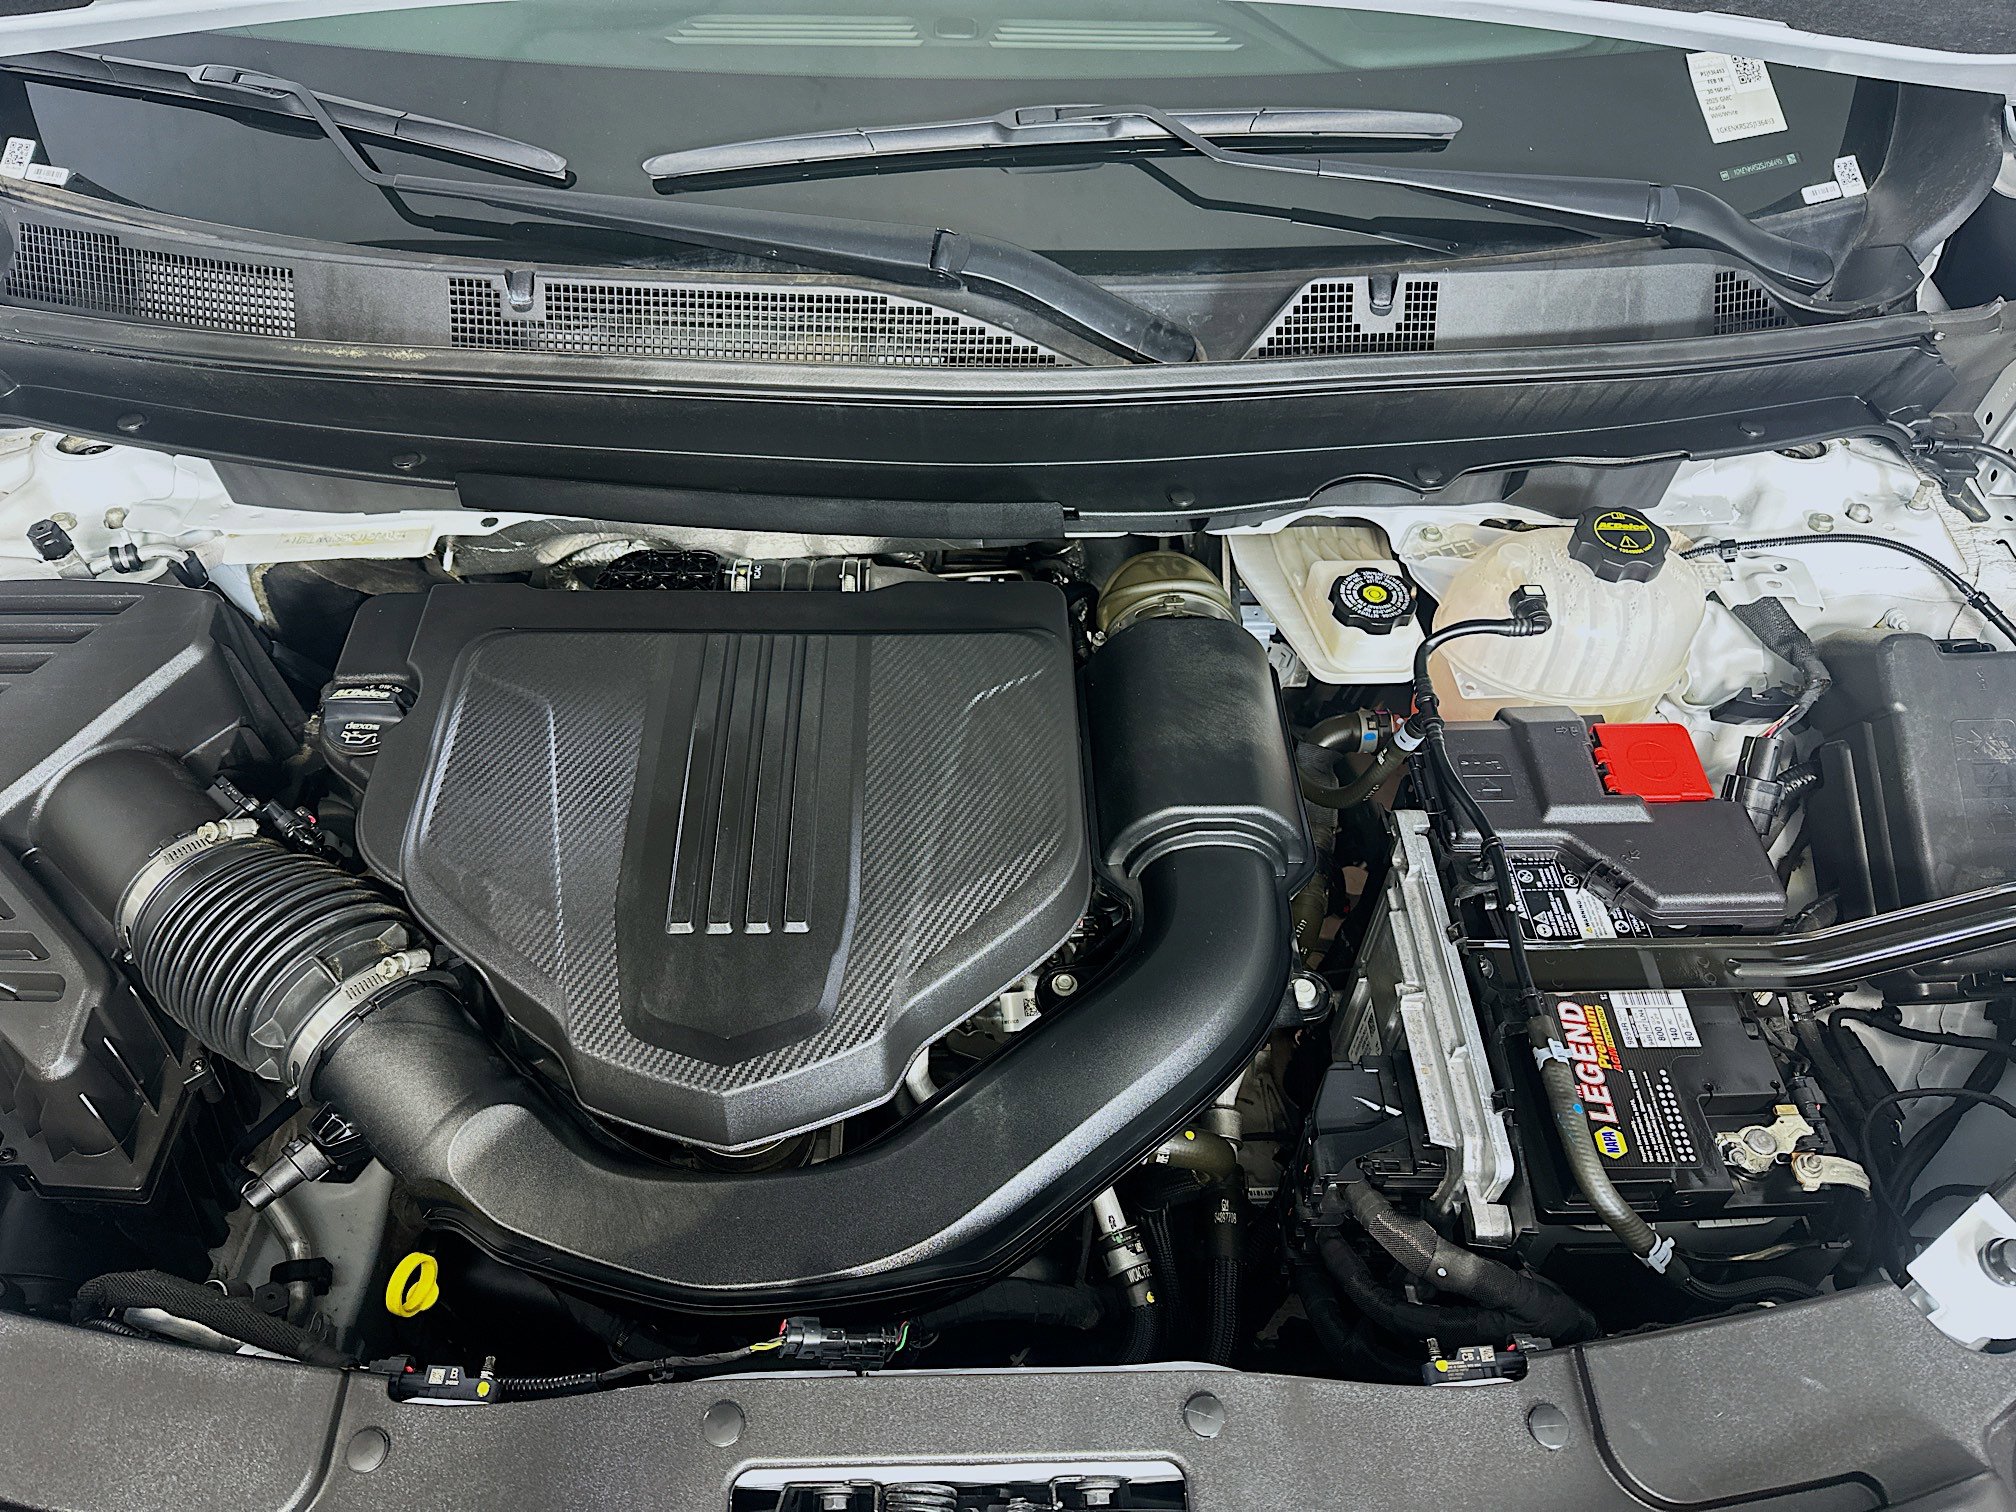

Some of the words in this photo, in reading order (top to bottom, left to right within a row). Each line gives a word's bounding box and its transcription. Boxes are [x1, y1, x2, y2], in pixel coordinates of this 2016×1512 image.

[1705, 97, 1718, 105] 2025
[1597, 522, 1648, 531] ACDelco
[329, 689, 391, 700] ACDelco
[1638, 1010, 1646, 1021] LN4
[1597, 1006, 1614, 1046] TECHNOLOGY
[1583, 1004, 1613, 1070] Premium
[1621, 1023, 1634, 1044] 9894R
[1655, 1027, 1666, 1041] 800
[1669, 1028, 1679, 1040] 140
[1685, 1032, 1694, 1041] 80
[1556, 1000, 1619, 1124] LEGEND
[1607, 1046, 1624, 1073] AGM
[1601, 1130, 1621, 1154] NAPA
[1461, 1352, 1475, 1362] CB
[449, 1367, 459, 1379] B
